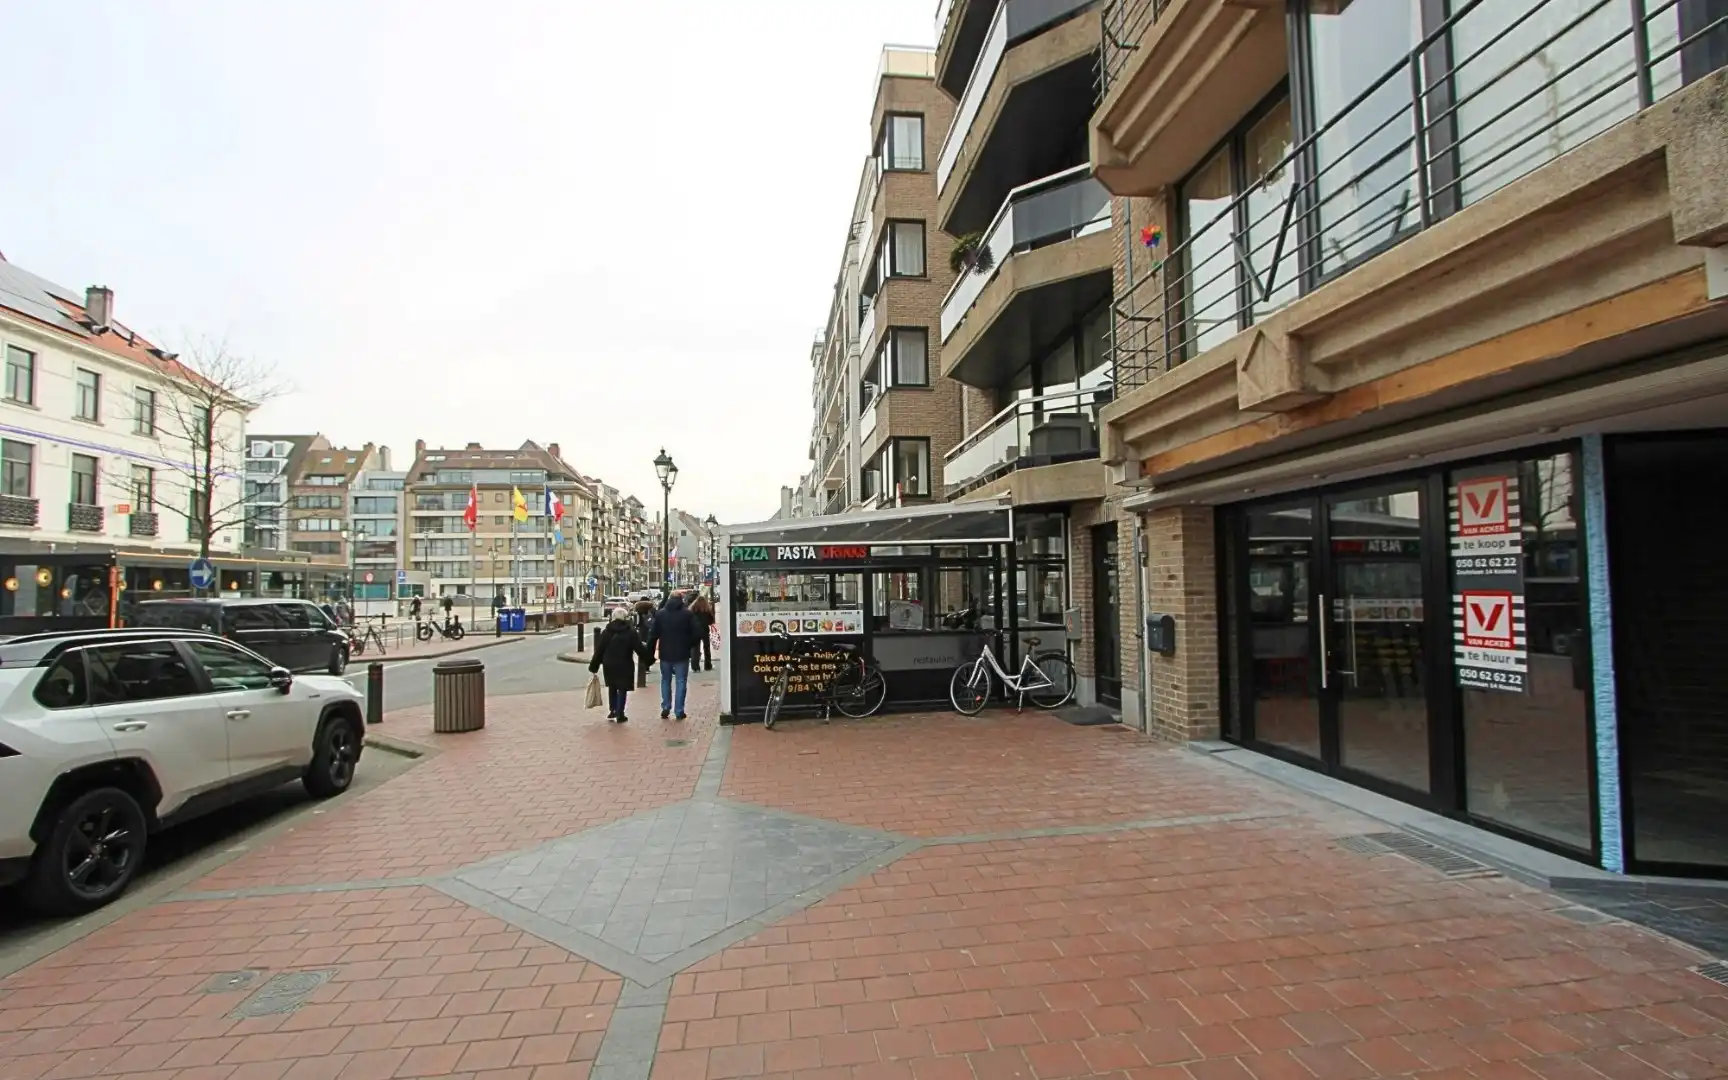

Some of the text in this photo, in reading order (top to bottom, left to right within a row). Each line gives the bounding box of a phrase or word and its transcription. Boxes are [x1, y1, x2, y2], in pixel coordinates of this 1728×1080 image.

[1462, 524, 1506, 535] VAN ACKER
[1463, 538, 1506, 550] te koop
[731, 546, 769, 561] PIZZA
[777, 545, 816, 560] PASTA
[1455, 557, 1516, 568] 050 62 62 22
[1467, 637, 1511, 648] VAN ACKER
[754, 654, 776, 663] Take
[777, 654, 801, 662] Aw
[813, 652, 850, 661] Delivy
[1468, 651, 1511, 664] te huur
[753, 665, 771, 673] Ook
[1459, 668, 1522, 684] 050 62 62 22
